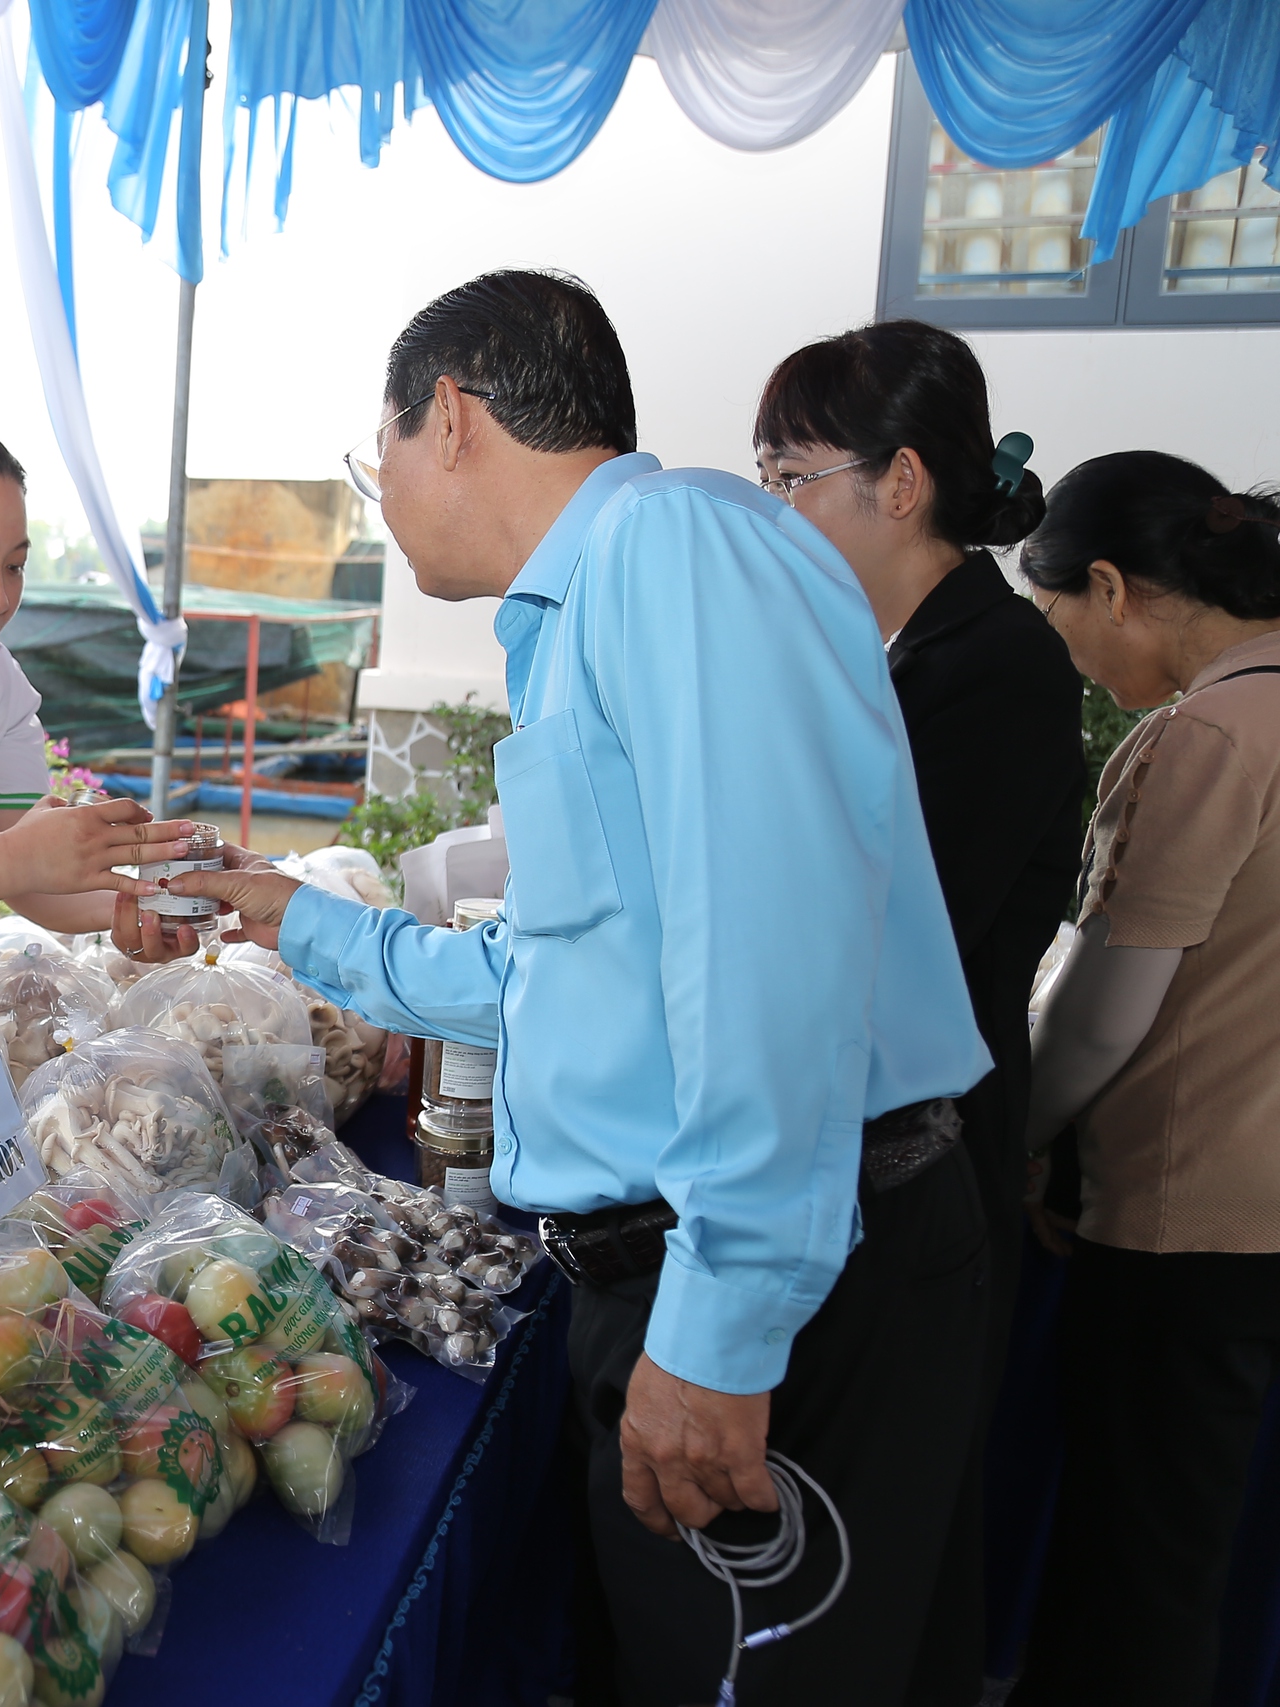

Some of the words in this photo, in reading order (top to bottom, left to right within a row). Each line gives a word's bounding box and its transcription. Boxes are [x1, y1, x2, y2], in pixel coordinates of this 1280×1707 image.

[61, 1246, 112, 1286] AU
[218, 1276, 289, 1348] RAU
[69, 1339, 124, 1400] AN
[125, 1369, 147, 1393] CHẤT
[133, 1386, 160, 1417] NGHIỆP
